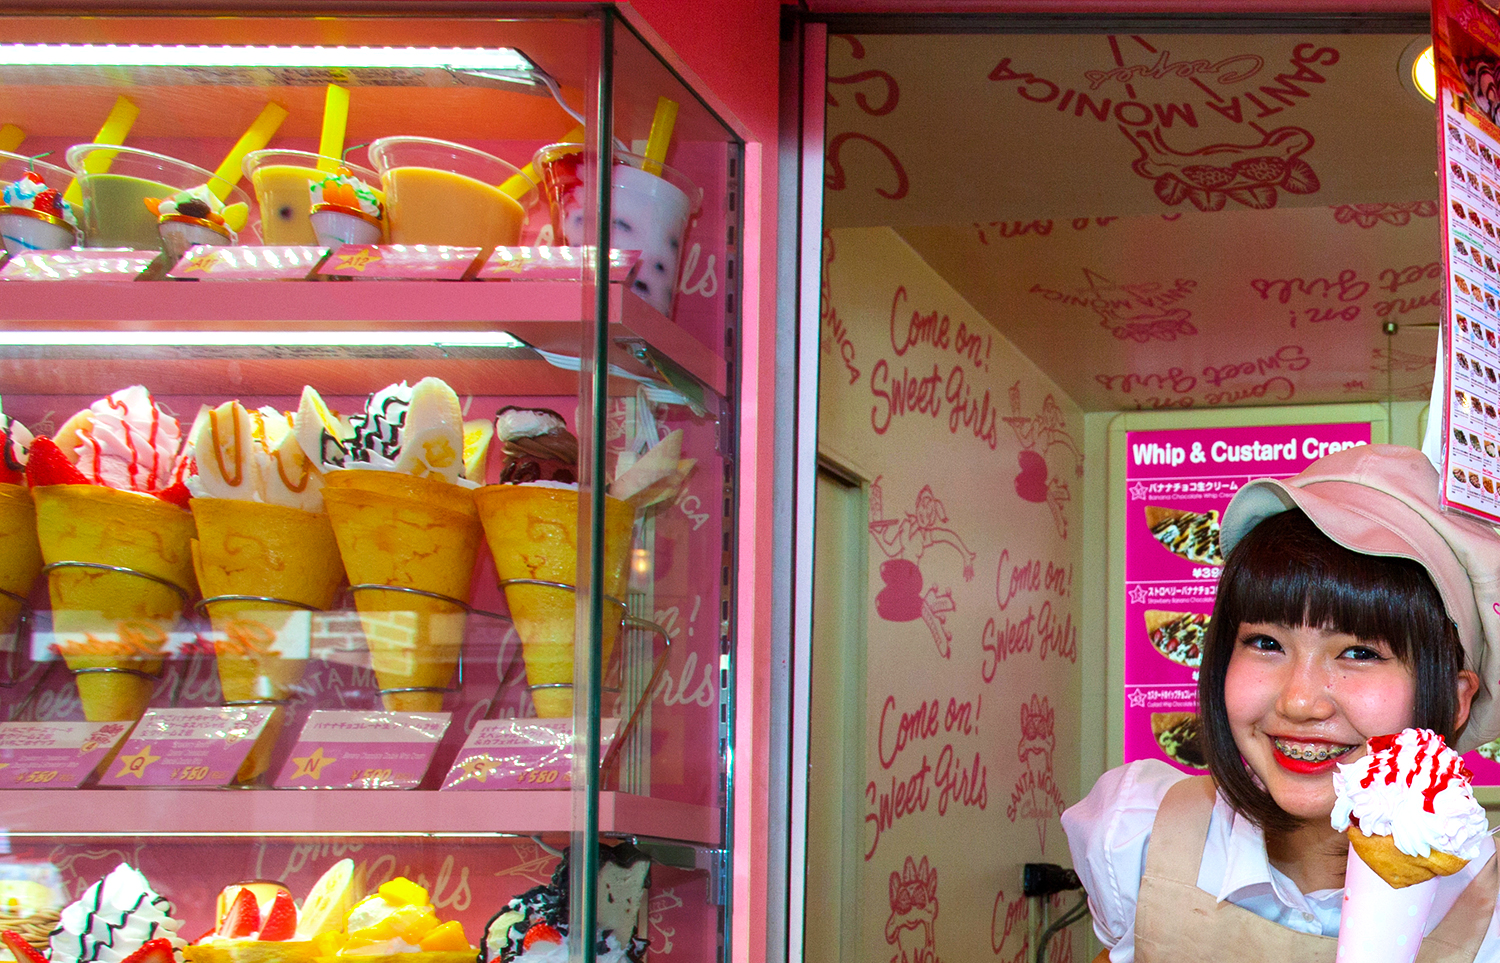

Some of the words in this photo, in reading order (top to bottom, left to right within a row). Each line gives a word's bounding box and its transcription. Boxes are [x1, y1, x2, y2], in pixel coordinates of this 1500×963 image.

[988, 57, 1198, 128] MONICA
[1220, 43, 1340, 123] SANTA
[346, 256, 368, 268] A12
[1251, 270, 1369, 303] Girls
[890, 286, 950, 355] Come
[955, 334, 992, 372] on!
[1096, 367, 1196, 393] Girls
[1204, 346, 1308, 387] Sweet
[871, 359, 942, 435] Sweet
[945, 366, 997, 449] Girls
[1133, 443, 1186, 467] Whip
[1190, 442, 1206, 463] &
[1211, 438, 1297, 463] Custard
[1148, 481, 1238, 493] バナナチョコ生クリーム
[996, 549, 1041, 611] Come
[1045, 561, 1073, 597] on!
[981, 605, 1035, 684] Sweet
[1037, 600, 1078, 664] Girls
[878, 695, 940, 770] Come
[944, 693, 982, 735] on!
[130, 757, 145, 771] Q
[170, 766, 209, 781] ¥580
[303, 758, 320, 772] N
[474, 762, 485, 771] S
[517, 770, 558, 784] ¥580
[935, 744, 988, 817] Girls
